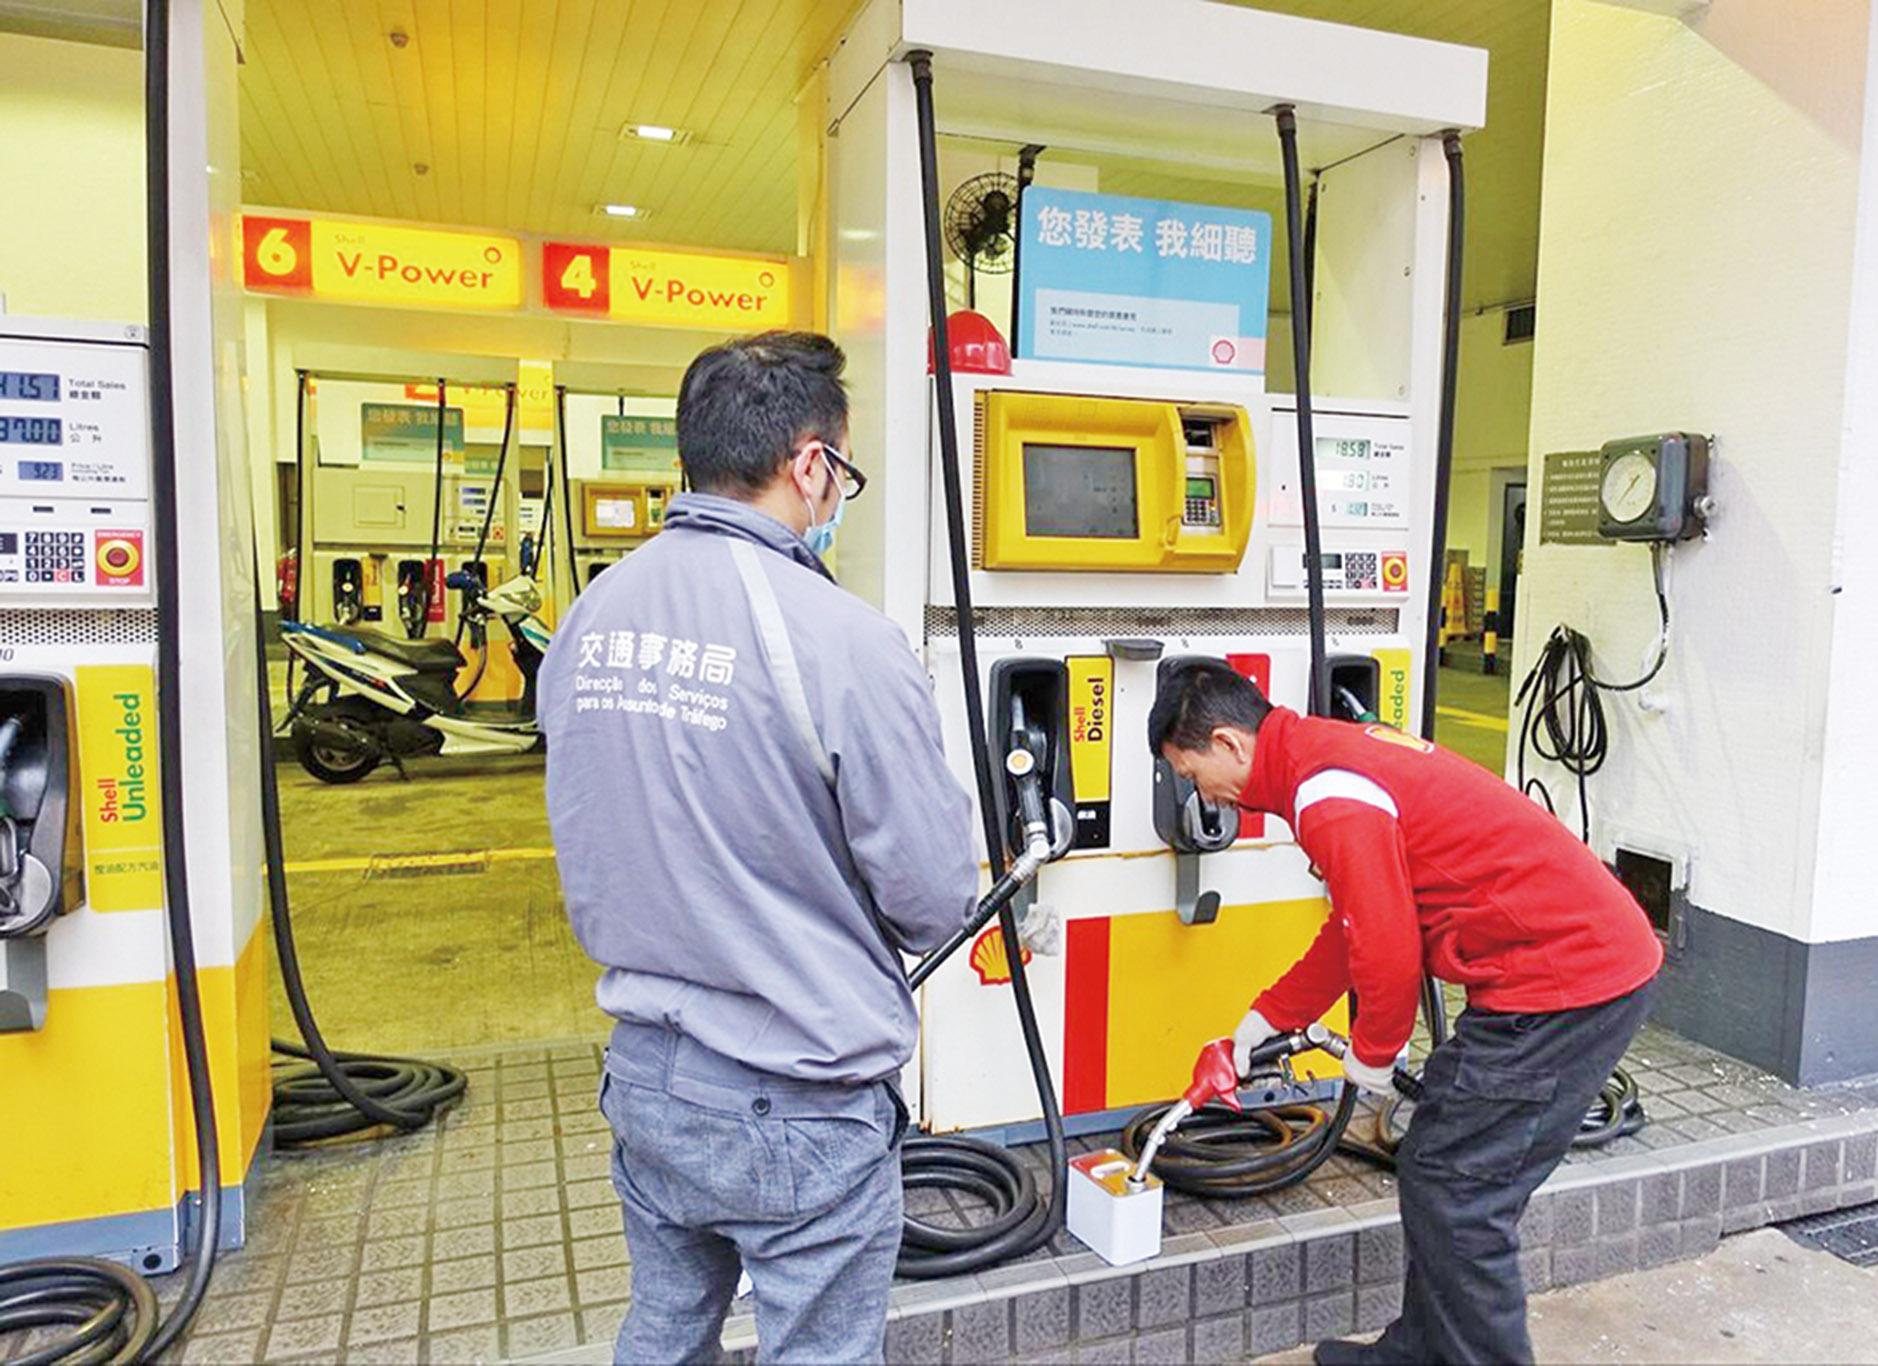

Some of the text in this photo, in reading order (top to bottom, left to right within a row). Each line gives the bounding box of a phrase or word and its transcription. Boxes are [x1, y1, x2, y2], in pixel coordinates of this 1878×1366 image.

[257, 228, 297, 276] 6
[1038, 207, 1257, 264] 您發表 我細聽
[337, 251, 494, 288] V-Power
[561, 255, 596, 299] 4
[632, 276, 768, 311] V-Power
[579, 630, 736, 685] 交通事務局
[668, 684, 728, 710] Serviços
[1087, 677, 1104, 741] Diesel
[1074, 706, 1085, 743] Shell
[113, 693, 147, 821] Unleaded
[98, 778, 118, 822] Shell
